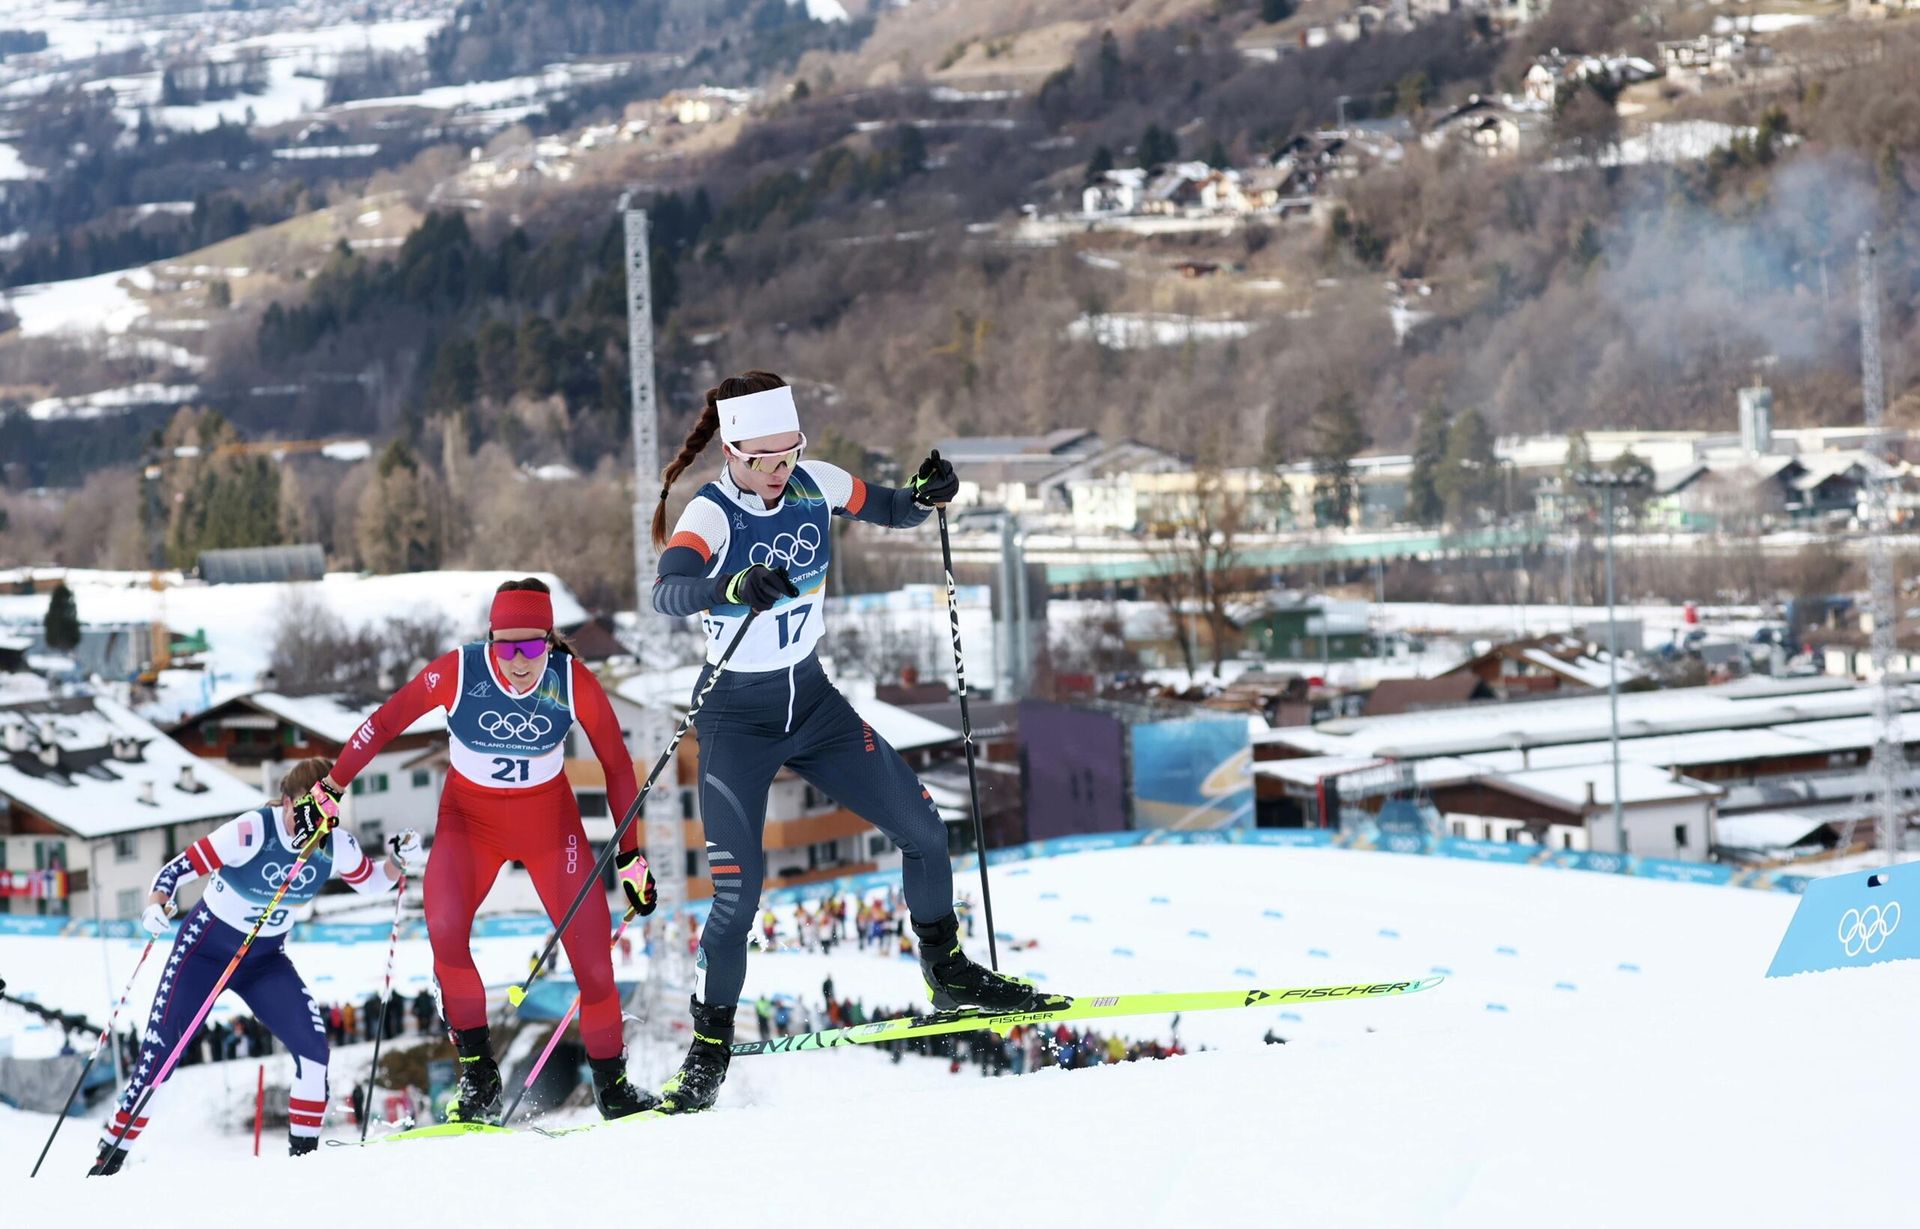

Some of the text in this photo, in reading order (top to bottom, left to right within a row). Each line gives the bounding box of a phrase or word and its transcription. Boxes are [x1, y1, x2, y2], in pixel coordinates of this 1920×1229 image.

[775, 603, 813, 650] 17
[471, 740, 505, 749] MILANO
[506, 743, 540, 751] CORTINA
[491, 757, 530, 783] 21
[565, 834, 577, 875] odlo
[243, 906, 289, 927] 29
[1279, 981, 1411, 1000] FISCHER
[989, 1012, 1054, 1025] FISCHER
